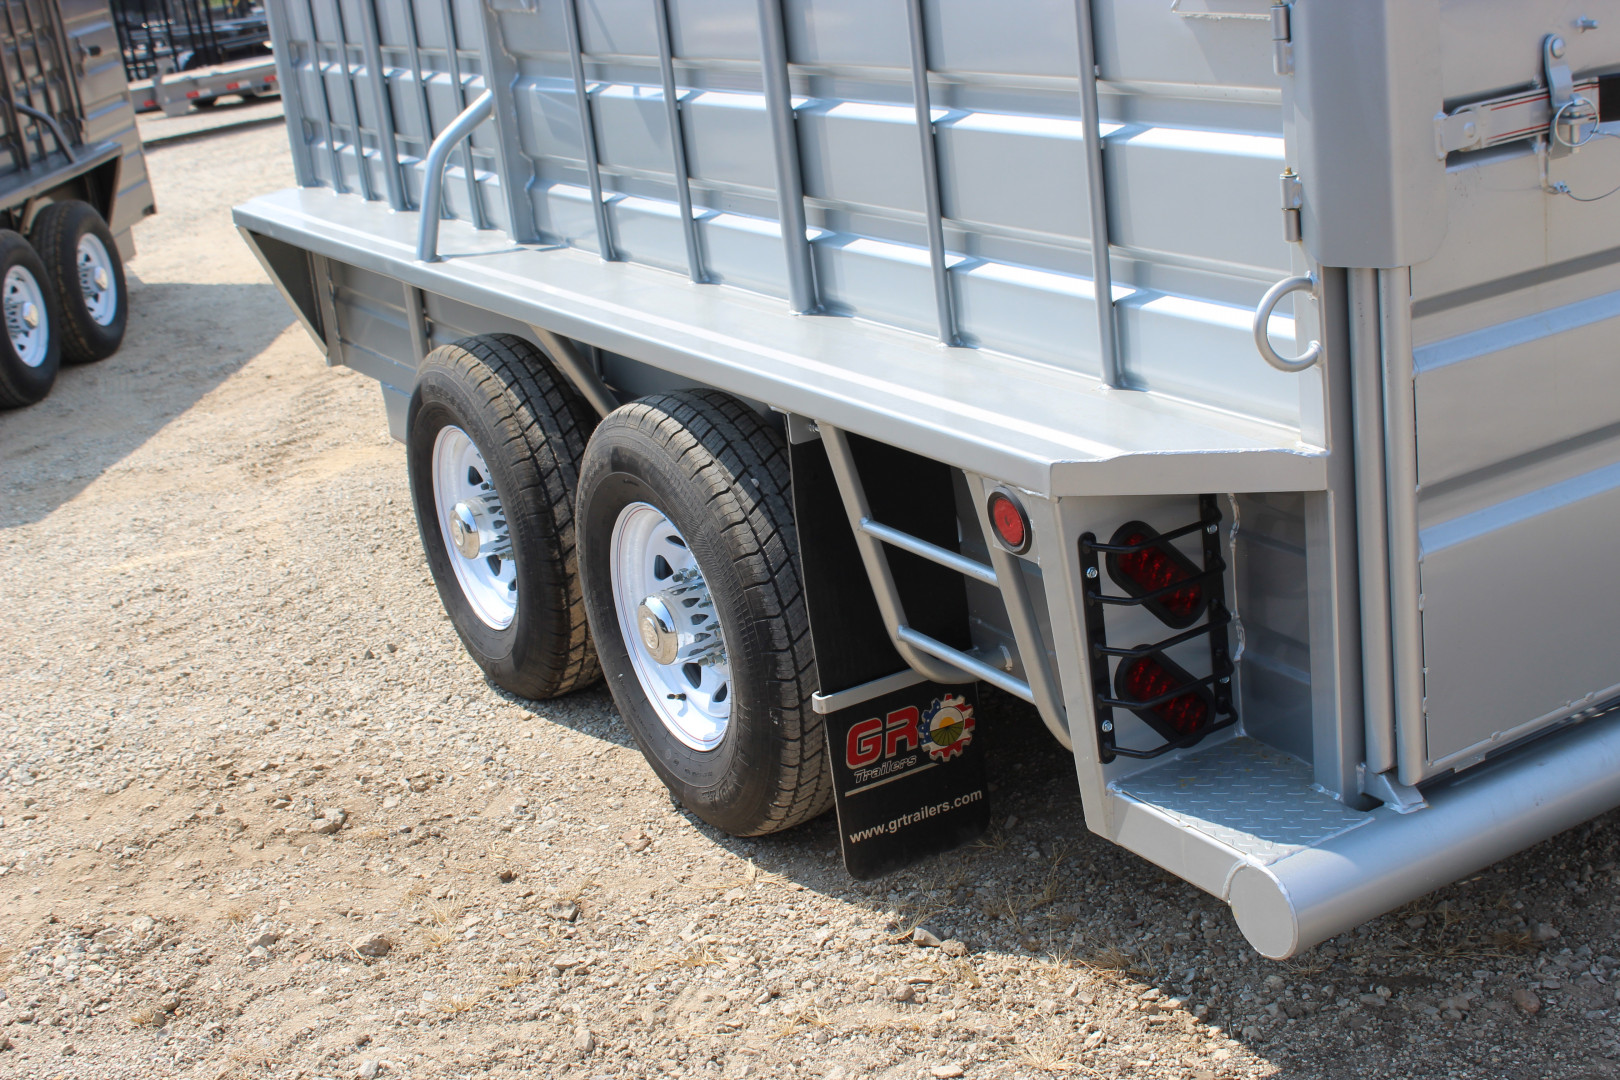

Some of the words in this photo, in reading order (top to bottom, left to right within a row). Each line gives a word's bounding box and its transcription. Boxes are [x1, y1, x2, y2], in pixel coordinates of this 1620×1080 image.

[846, 705, 919, 770] GR
[854, 755, 917, 783] Trailers
[849, 789, 982, 843] www.grtrailers.com
